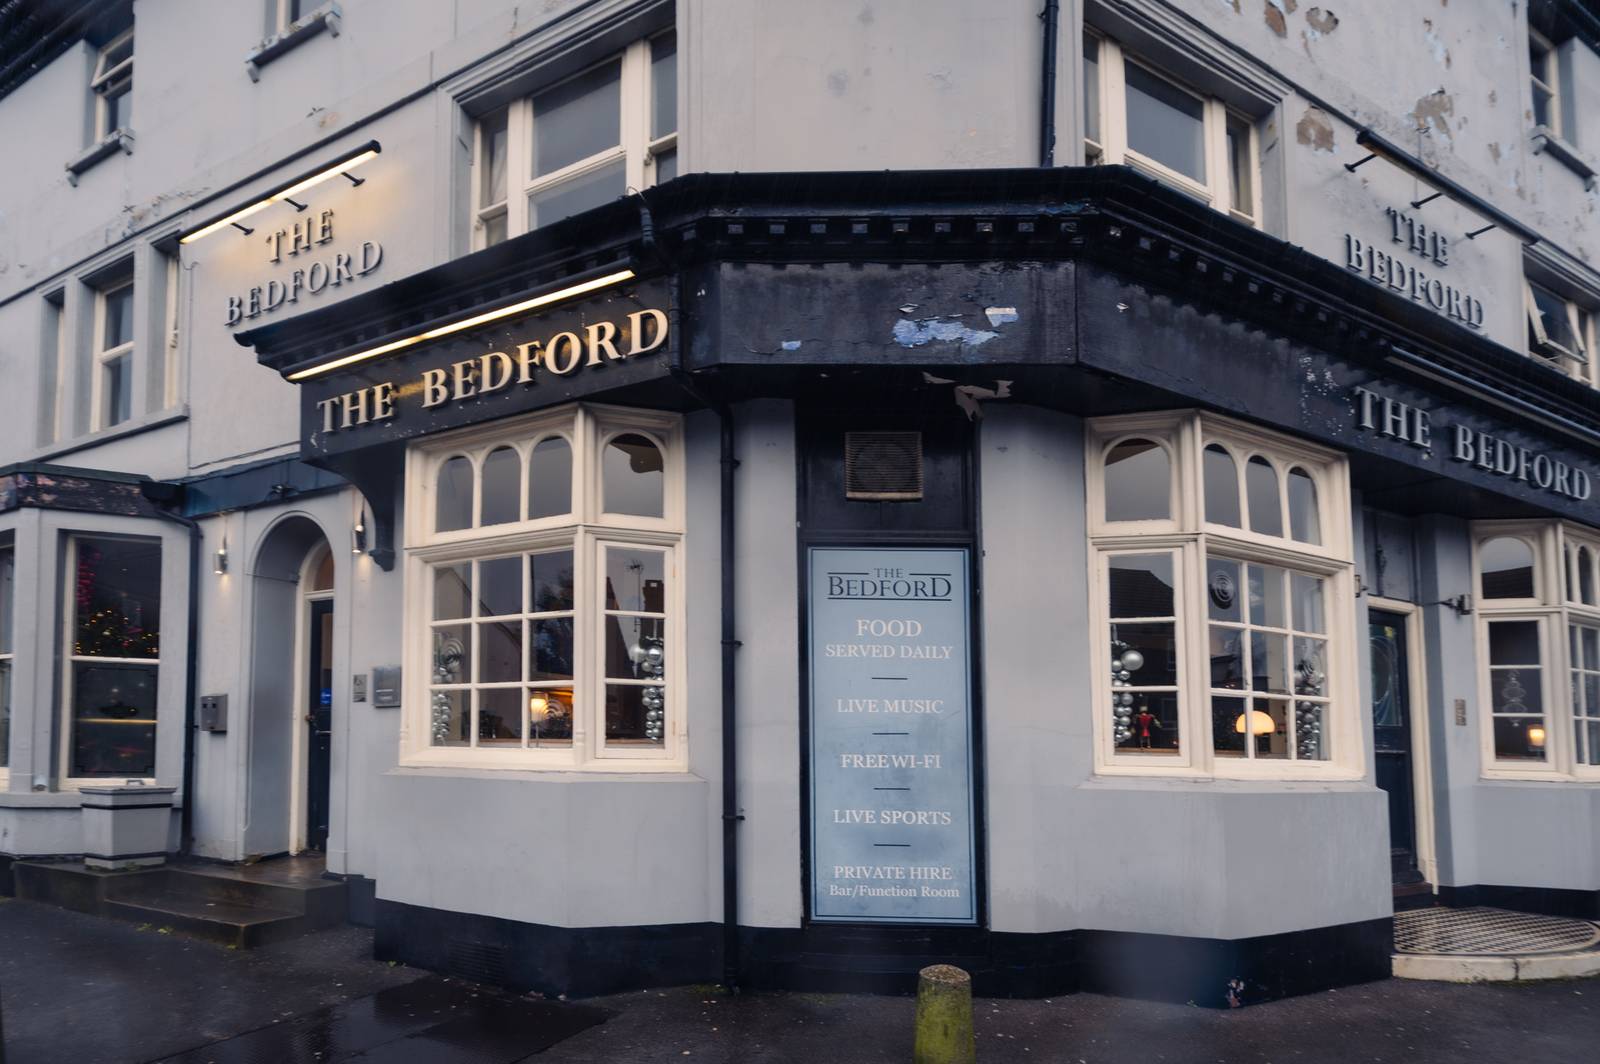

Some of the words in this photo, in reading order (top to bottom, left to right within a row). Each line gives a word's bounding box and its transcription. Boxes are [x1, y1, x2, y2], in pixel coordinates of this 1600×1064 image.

[266, 208, 335, 264] THE
[1385, 206, 1449, 267] THE
[224, 240, 384, 327] BEDFORD
[1344, 233, 1484, 330] BEDFORD
[316, 382, 393, 433] THE
[421, 308, 670, 408] BEDFORD
[1354, 386, 1432, 448] THE
[1455, 423, 1592, 501] BEDFORD
[874, 568, 904, 578] THE
[828, 576, 952, 597] BEDFORD
[856, 619, 922, 637] FOOD
[825, 644, 895, 658] SERVED
[900, 645, 953, 659] DAILY
[837, 699, 879, 713] LIVE
[884, 699, 944, 714] MUSIC
[840, 754, 889, 768] FREE
[892, 754, 942, 768] WI-FI
[834, 810, 876, 824] LIVE
[880, 810, 952, 825] SPORTS
[833, 866, 905, 879] PRIVATE
[910, 867, 953, 880] HIRE
[829, 884, 917, 898] Bar/Function
[921, 886, 960, 897] Room
